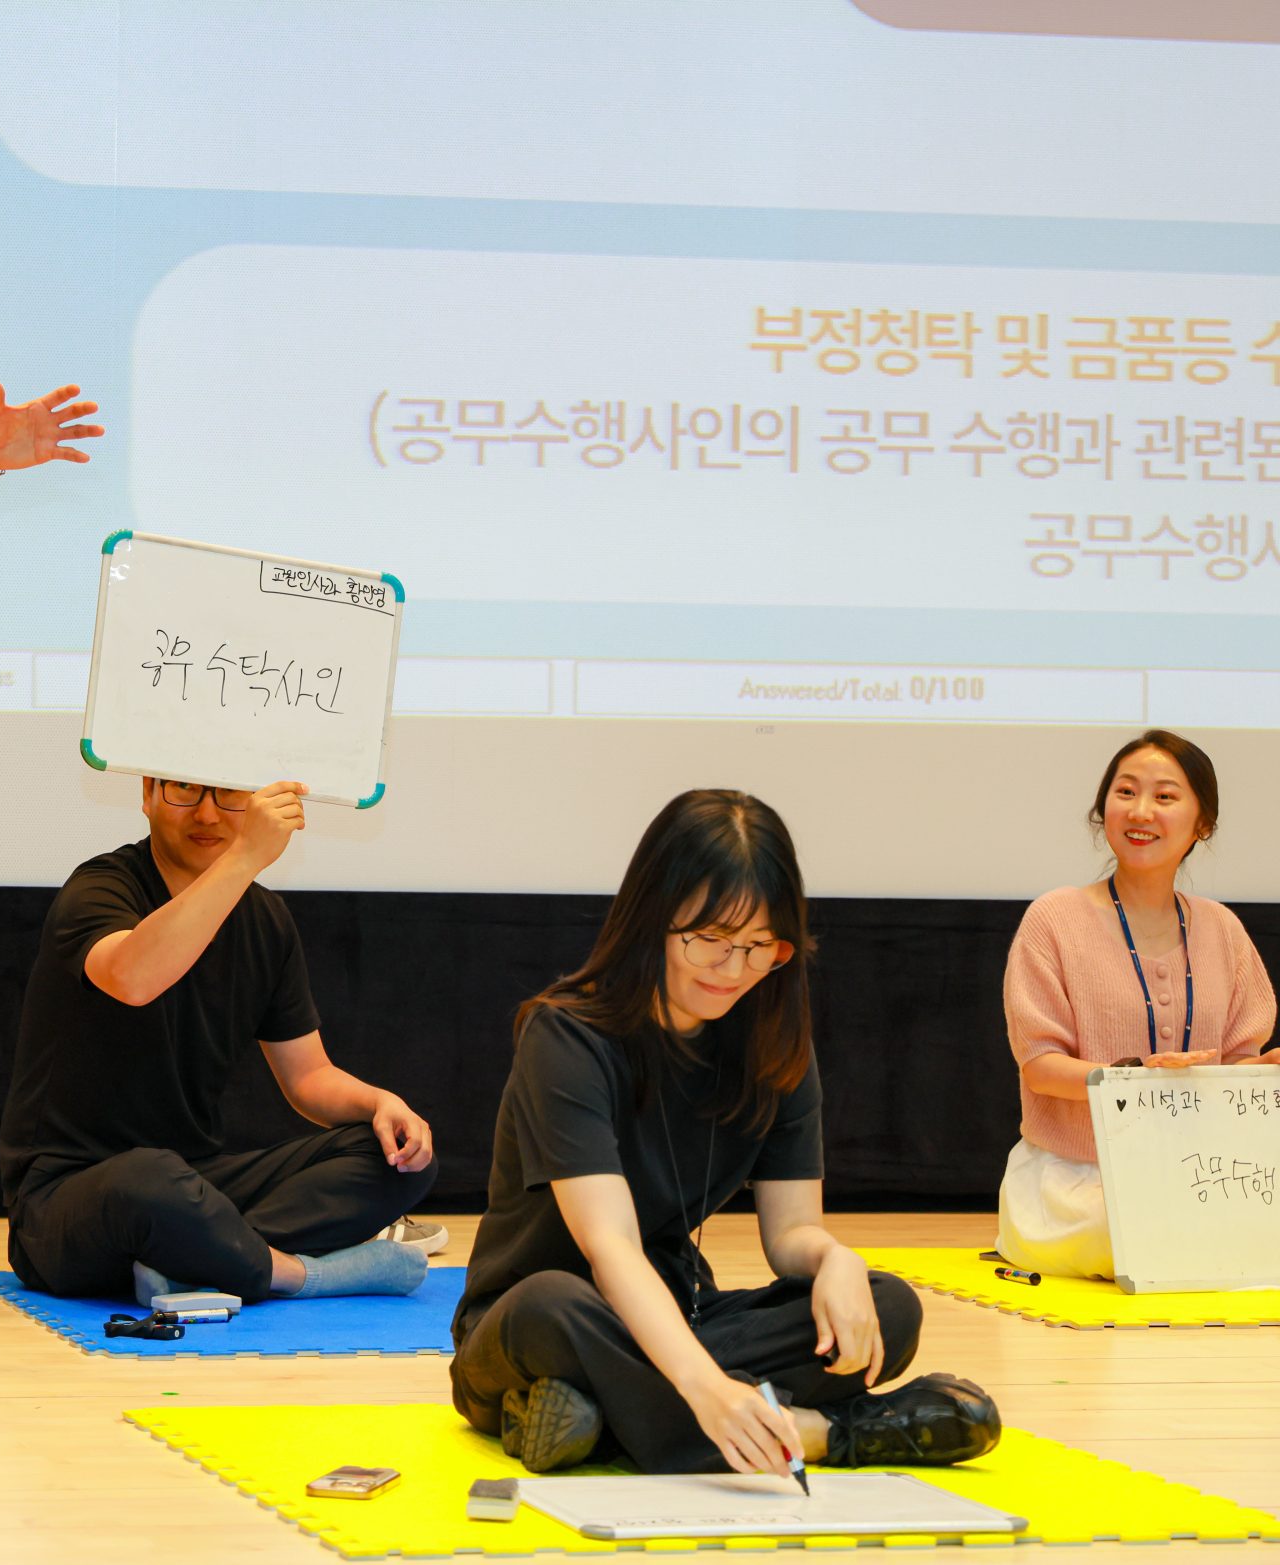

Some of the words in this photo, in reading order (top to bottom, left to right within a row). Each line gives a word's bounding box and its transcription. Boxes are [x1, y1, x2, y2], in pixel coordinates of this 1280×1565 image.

[748, 306, 983, 378] 부정청탁
[996, 313, 1051, 379] 및
[1065, 315, 1236, 384] 금품등
[369, 390, 800, 473] (공무수행사인의
[819, 408, 935, 476] 공무
[948, 411, 1122, 481] 수행과
[141, 629, 194, 701] 공무
[910, 675, 985, 705] 0/100
[1137, 1088, 1202, 1118] 시설과
